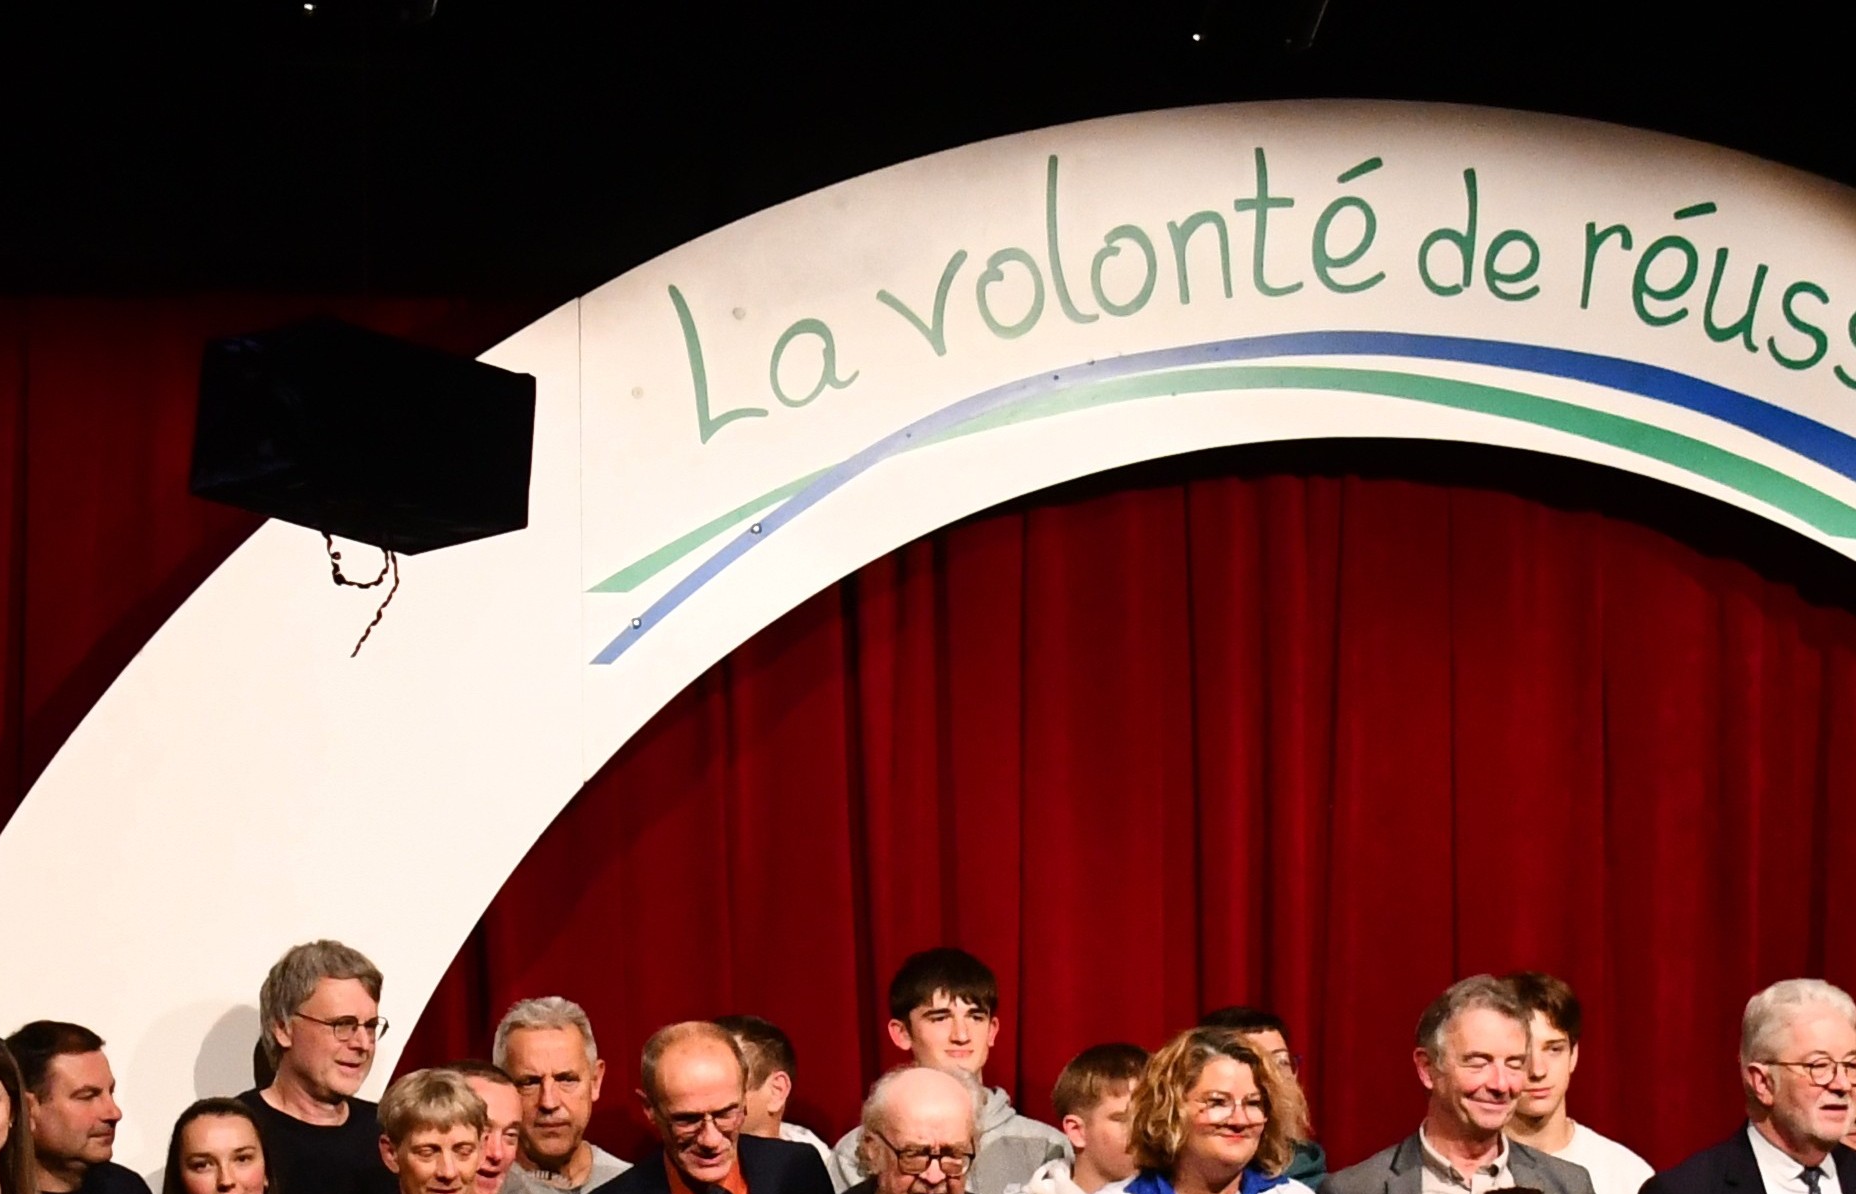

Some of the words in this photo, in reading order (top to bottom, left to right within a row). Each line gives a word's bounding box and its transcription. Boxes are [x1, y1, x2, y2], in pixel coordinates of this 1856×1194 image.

[667, 281, 858, 446] La
[875, 146, 1386, 359] volonté
[1416, 167, 1542, 302] de
